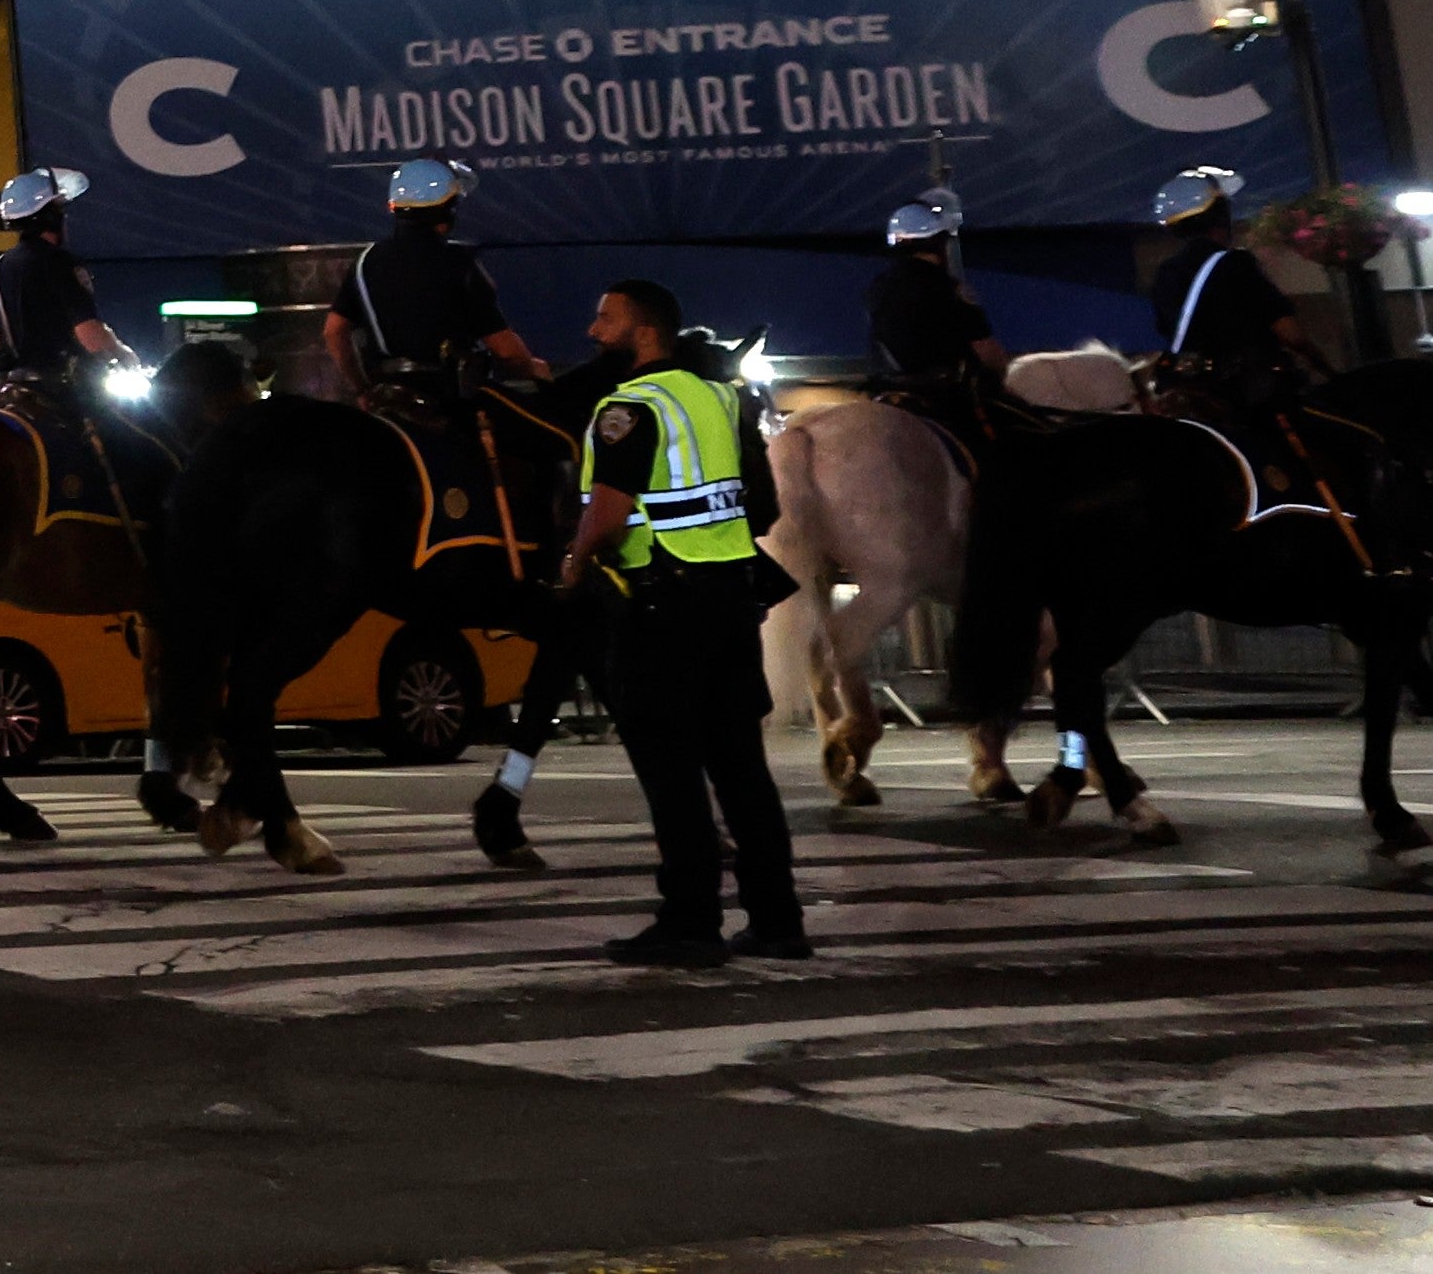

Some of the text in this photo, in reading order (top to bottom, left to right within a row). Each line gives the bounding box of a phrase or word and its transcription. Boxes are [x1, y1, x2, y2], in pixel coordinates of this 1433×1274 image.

[405, 13, 891, 68] CHASE ENTRANCE
[1100, 0, 1273, 133] C
[109, 56, 246, 177] C
[320, 60, 990, 154] MADISON SQUARE GARDEN
[601, 149, 668, 164] MOST
[683, 143, 788, 160] FAMOUS
